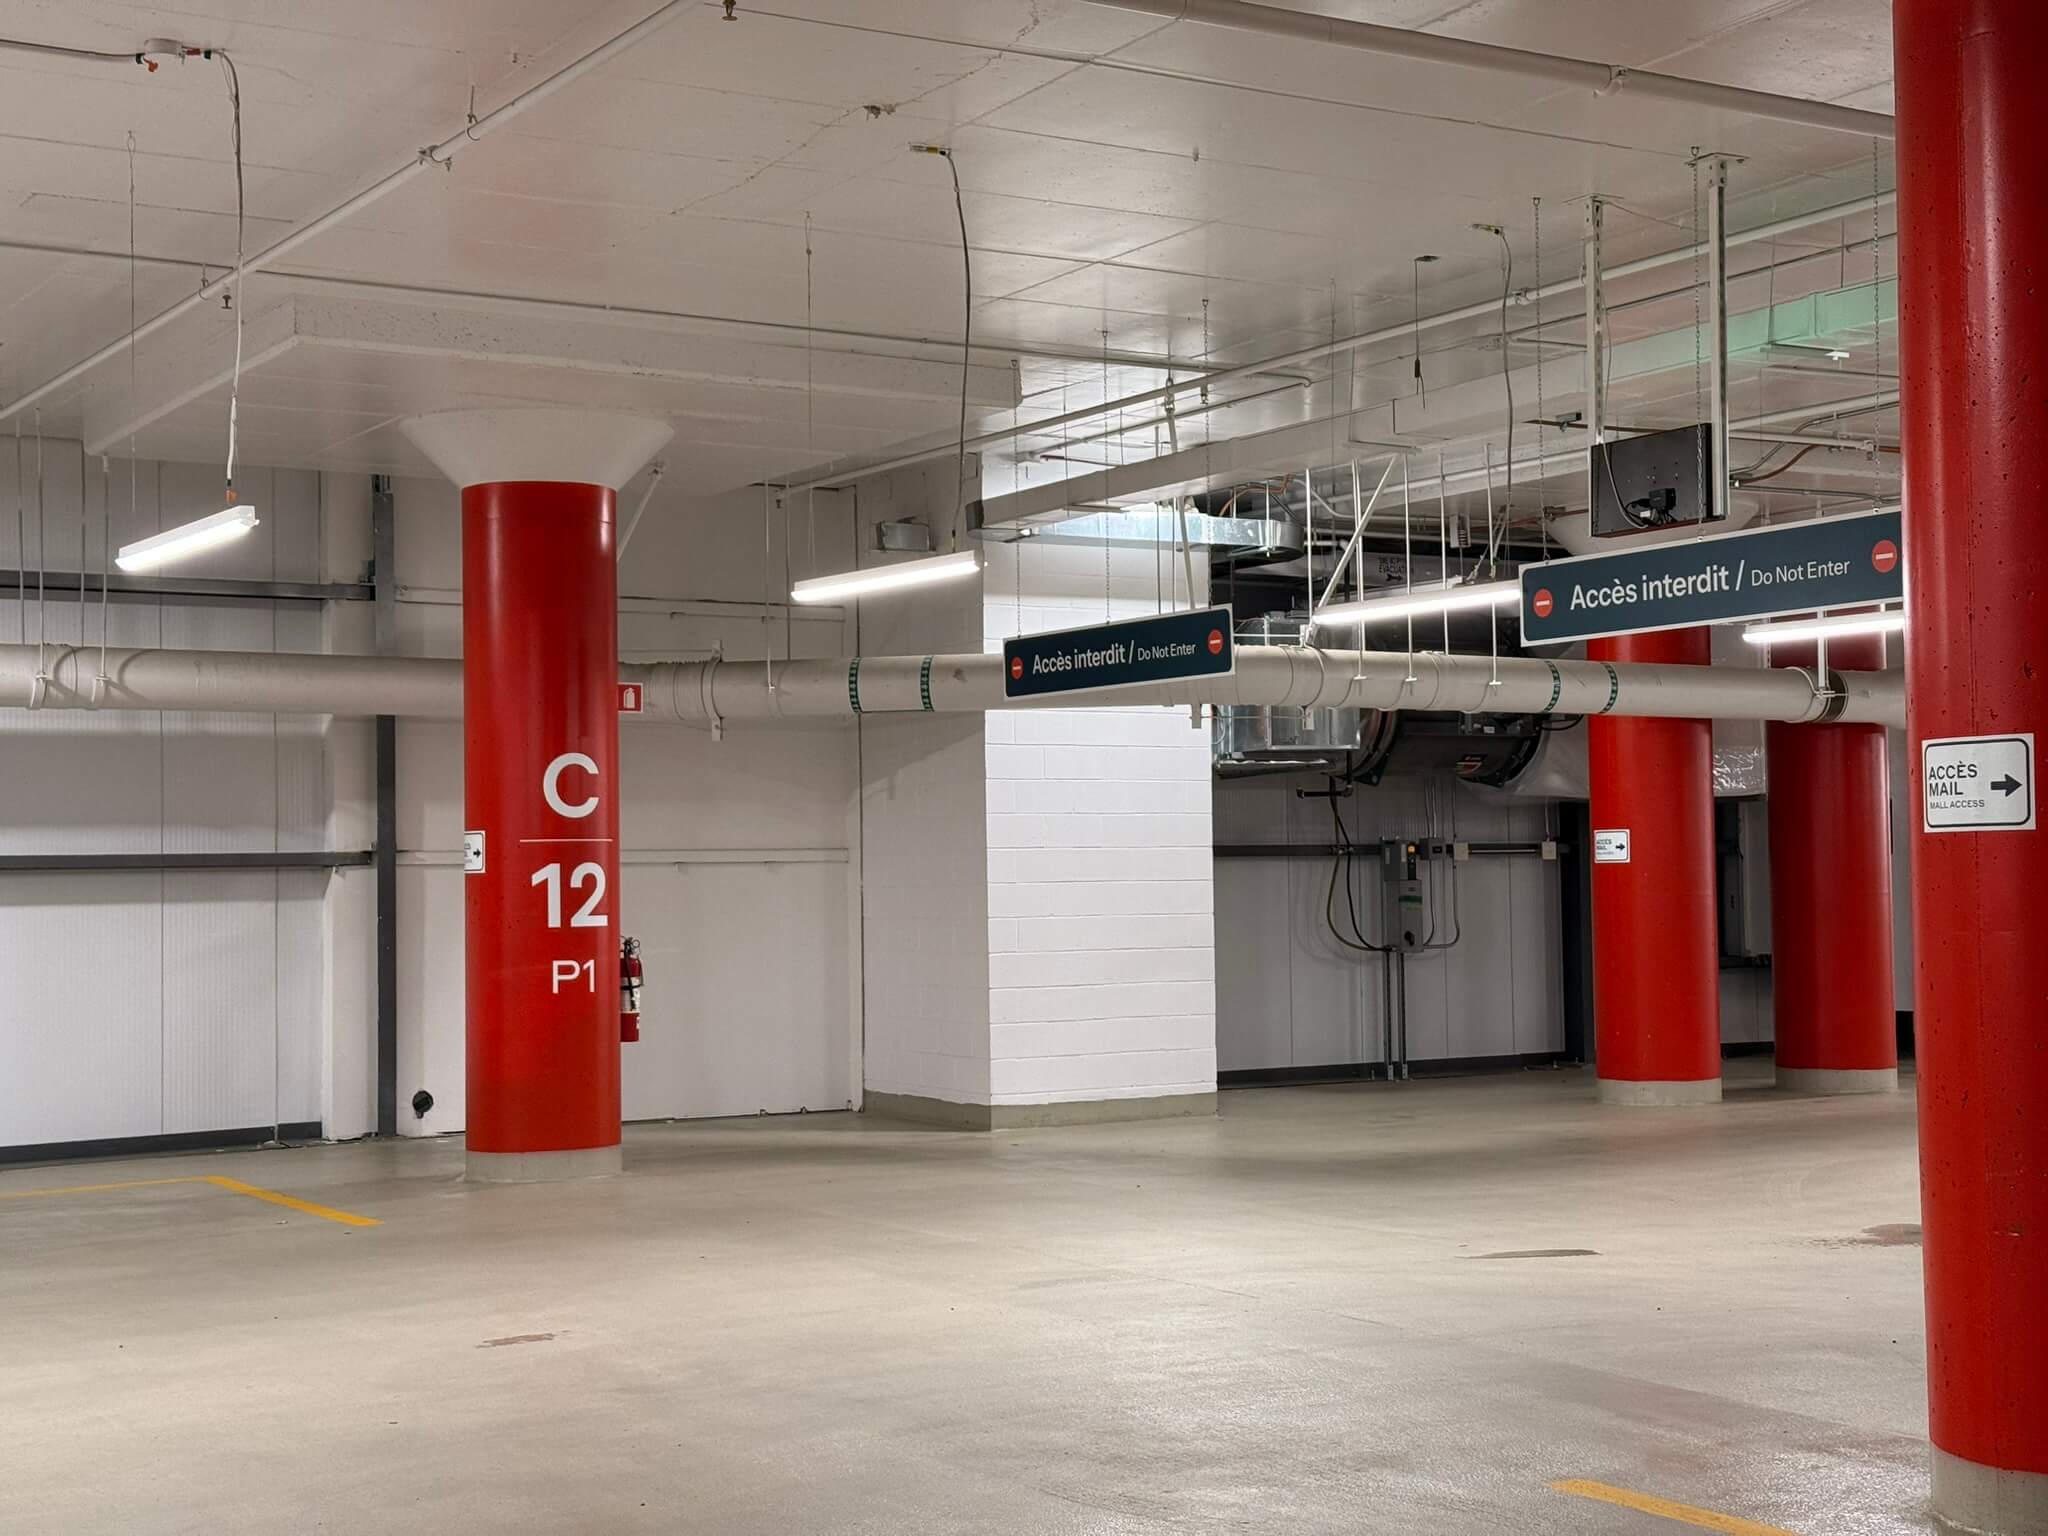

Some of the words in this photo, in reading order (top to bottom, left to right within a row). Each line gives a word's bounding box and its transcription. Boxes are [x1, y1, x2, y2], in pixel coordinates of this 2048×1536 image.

[1570, 578, 1638, 610] Accès
[1642, 565, 1730, 601] interdit
[1735, 560, 1745, 592] /
[1751, 569, 1773, 587] Do
[1775, 564, 1804, 584] Not
[1807, 560, 1850, 579] Enter
[1033, 650, 1073, 675] Accès
[1074, 642, 1126, 669] interdit
[1128, 639, 1135, 664] /
[1137, 647, 1151, 661] Do
[1152, 645, 1170, 659] Not
[1170, 643, 1196, 657] Enter
[544, 752, 599, 818] C
[1929, 760, 1978, 780] ACCÈS
[1929, 782, 1964, 796] MAIL
[1930, 801, 1949, 809] MALL
[1950, 800, 1985, 809] ACCESS
[531, 862, 609, 928] 12
[552, 959, 595, 994] P1
